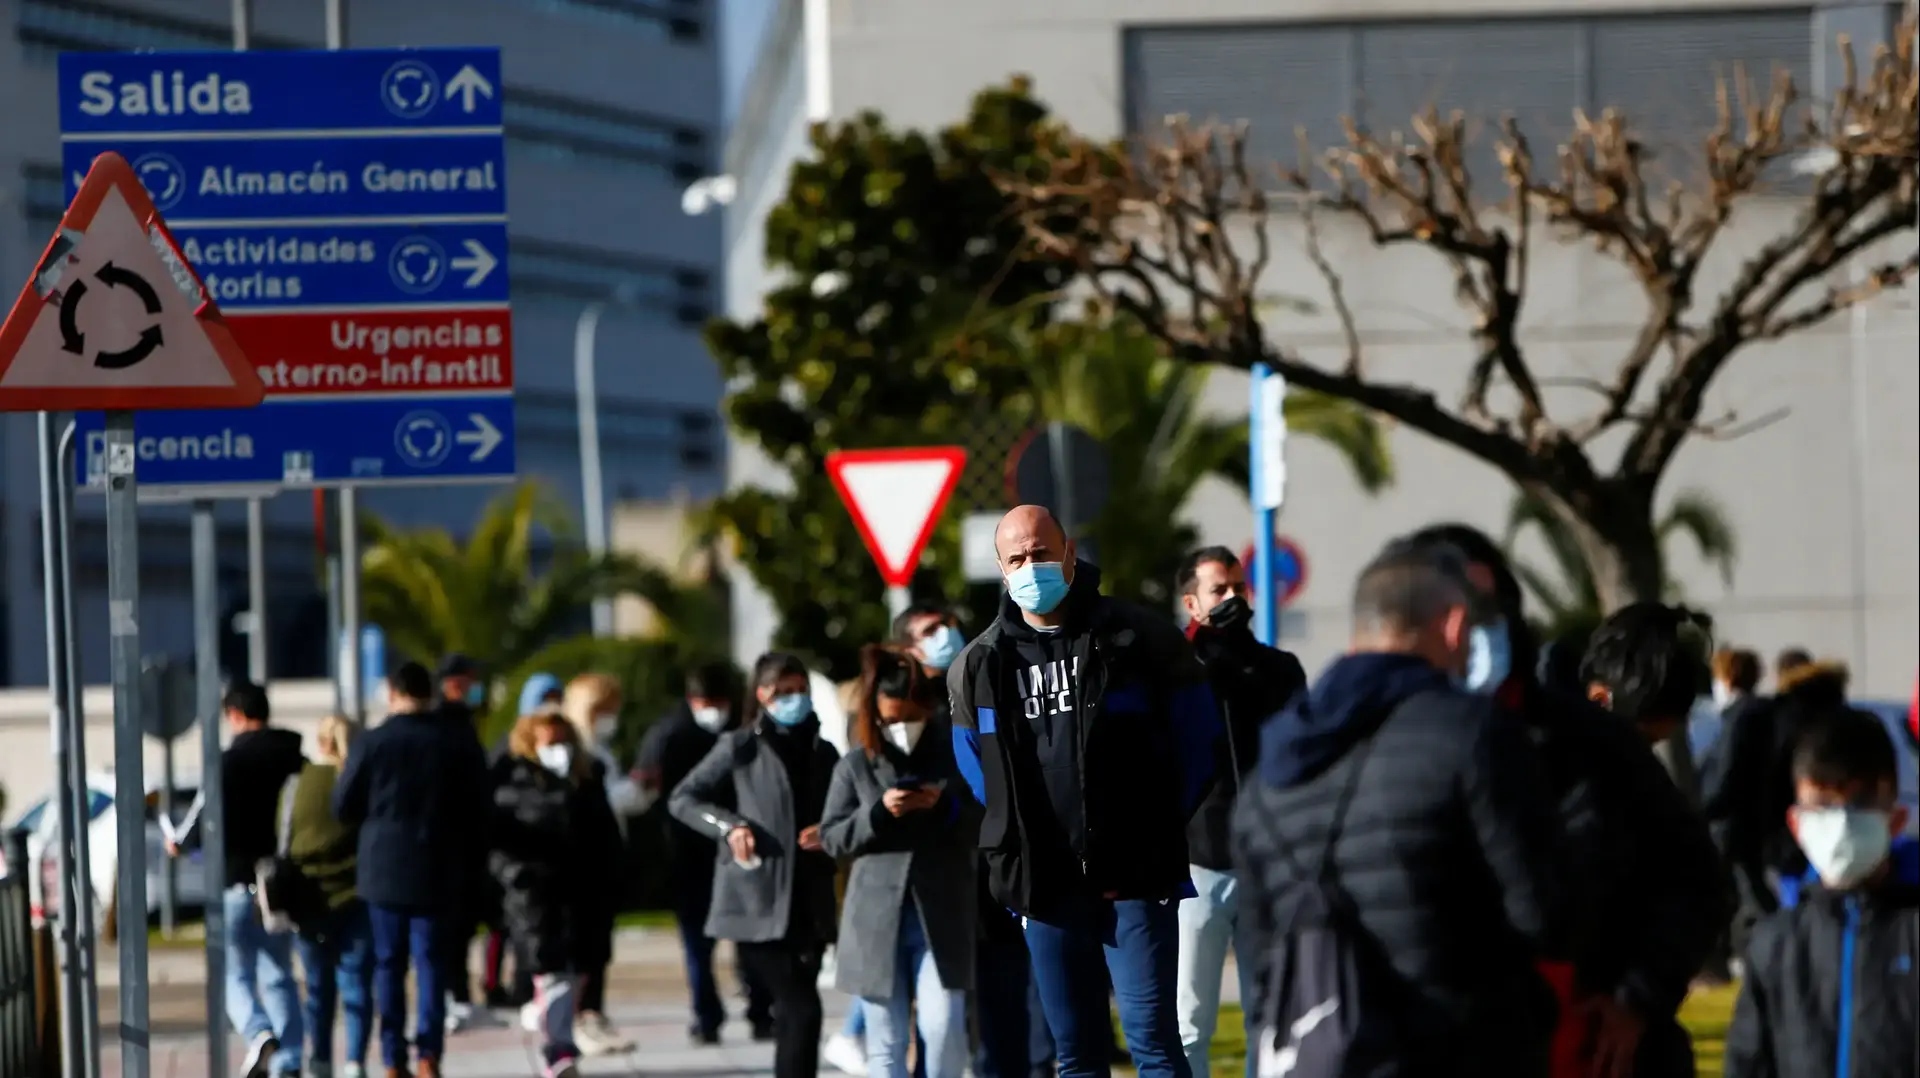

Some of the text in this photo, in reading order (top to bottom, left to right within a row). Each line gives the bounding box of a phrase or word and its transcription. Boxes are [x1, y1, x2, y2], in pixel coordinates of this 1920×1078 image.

[79, 70, 252, 116] Salida
[199, 161, 496, 196] Almacén General
[184, 236, 376, 265] Actividades
[331, 319, 502, 355] Urgencias
[86, 428, 254, 461] Dcencia
